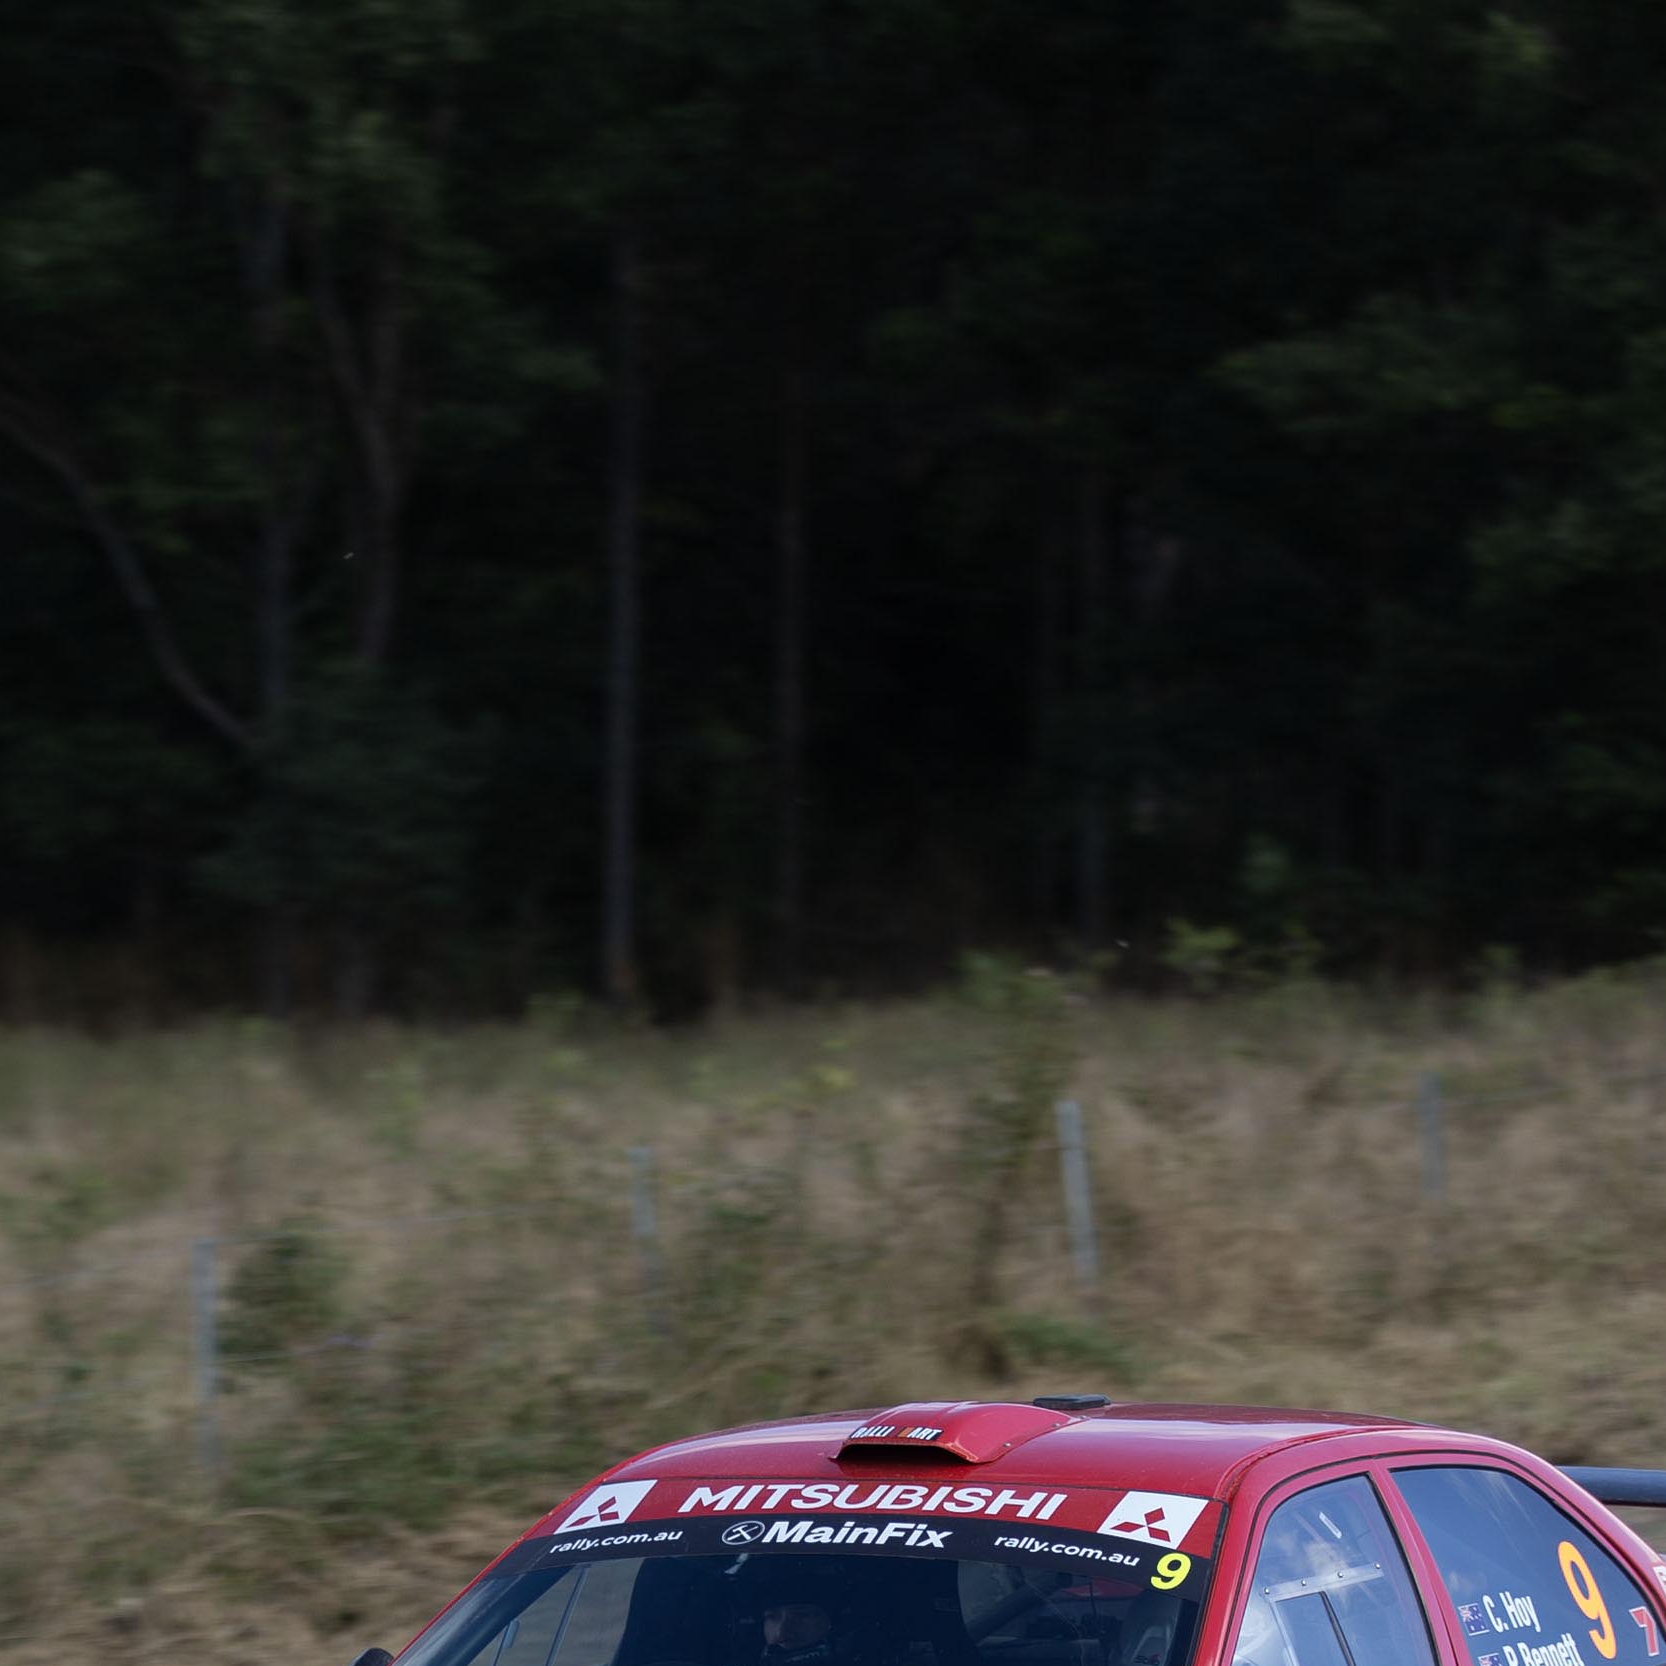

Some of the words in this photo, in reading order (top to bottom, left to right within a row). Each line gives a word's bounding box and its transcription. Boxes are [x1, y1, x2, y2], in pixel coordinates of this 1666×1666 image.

[677, 1484, 1068, 1521] MITSUBISHI
[550, 1530, 683, 1554] rally.com.au
[761, 1521, 953, 1549] MainFix
[994, 1534, 1140, 1567] rally.com.au
[1150, 1552, 1192, 1591] 9
[1482, 1594, 1510, 1633] C.
[1499, 1591, 1542, 1633] Hoy
[1557, 1540, 1617, 1660] 9
